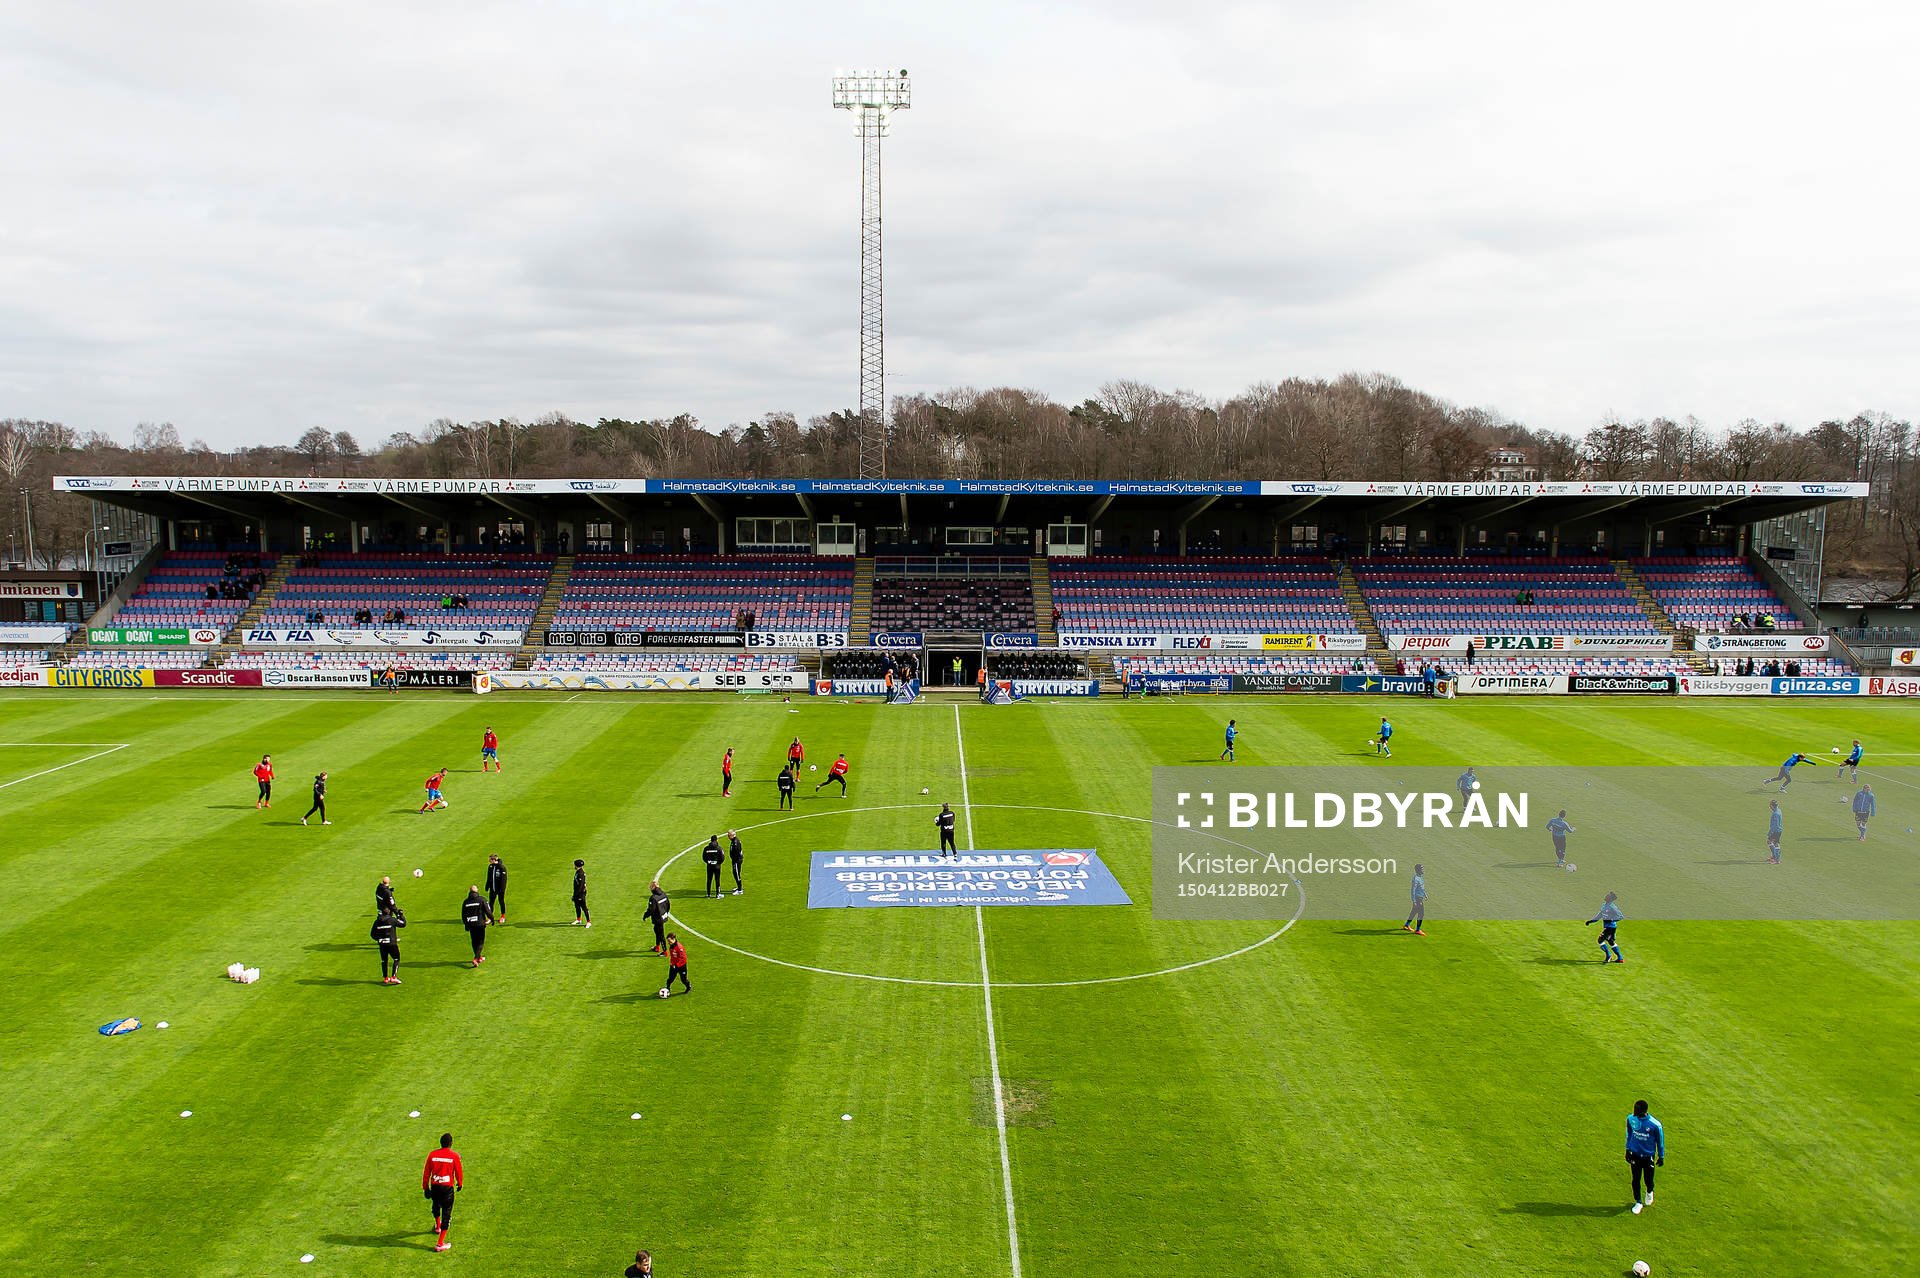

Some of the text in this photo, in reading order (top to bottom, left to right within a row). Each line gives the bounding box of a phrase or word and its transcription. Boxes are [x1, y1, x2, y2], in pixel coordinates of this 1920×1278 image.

[165, 478, 294, 491] VÄRMEPUMPAR
[374, 479, 500, 492] VÄRMEPUMPAR
[663, 481, 796, 491] HalmstadKylteknik.se
[812, 481, 945, 491] HalmstadKylteknik.se
[960, 482, 1094, 492] HalmstadKylteknik.se
[1109, 482, 1242, 492] HalmstadKylteknik.se
[1404, 481, 1531, 496] VÄRMEPUMPAR
[1619, 482, 1746, 495] VÄRMEPUMPAR
[196, 632, 215, 641] AXA
[248, 631, 277, 641] FLA
[286, 631, 315, 641] FLA
[779, 634, 804, 642] STÅL
[875, 633, 917, 646] Cervera
[990, 633, 1033, 646] Cervera
[1063, 637, 1157, 647] SVENSKA LYFT
[1327, 637, 1362, 645] Riksbyggen
[1722, 637, 1787, 647] STRÄNGBETONG
[1484, 637, 1553, 649] PEAB
[1804, 638, 1823, 647] AXA
[0, 669, 39, 682] edjan
[56, 669, 143, 686] CITY GROSS
[182, 671, 236, 684] Scandic
[287, 674, 368, 682] Oscar Hanson VVS
[409, 672, 459, 685] MÅLERI
[715, 675, 746, 686] SEB
[1243, 677, 1332, 685] YANKEE CANDLE
[1014, 681, 1091, 694] STRYKTIPSET
[1382, 678, 1425, 692] bravid
[1576, 679, 1668, 690] black&white art
[1693, 680, 1768, 694] Riksbyggen
[1779, 680, 1852, 694] ginza.se
[836, 870, 1089, 882] FOTBOLLSKLUBB
[846, 880, 1086, 892] HELA SVERIGES
